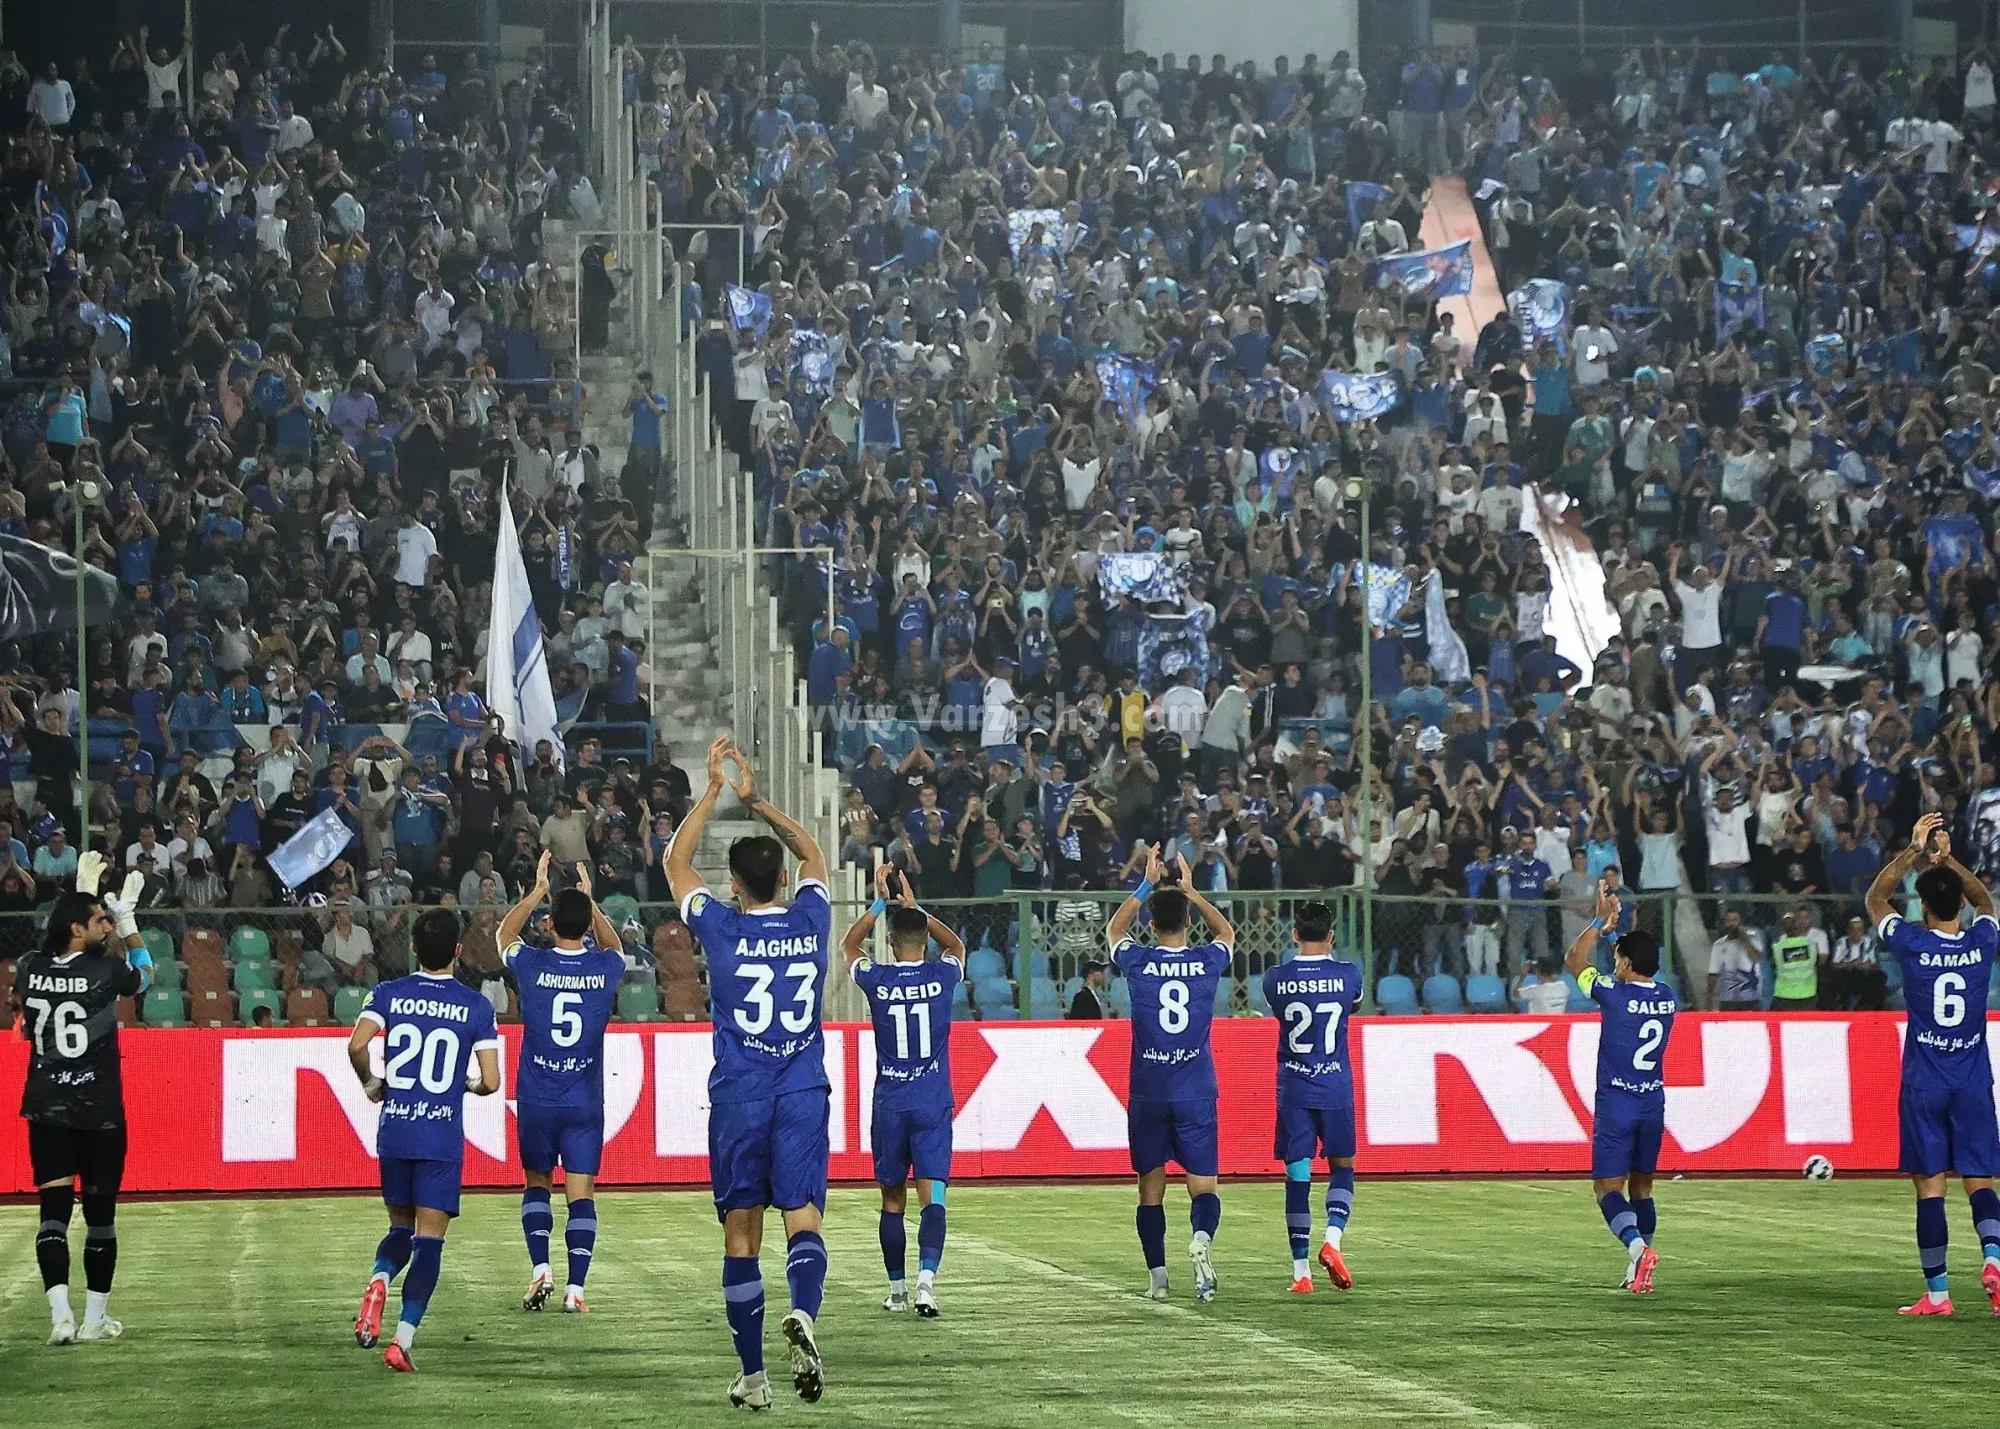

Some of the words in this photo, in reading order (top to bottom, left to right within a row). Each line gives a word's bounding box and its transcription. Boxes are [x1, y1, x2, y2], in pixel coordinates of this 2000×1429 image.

[735, 934, 818, 958] A.AGHASI
[1919, 948, 1982, 967] SAMAN
[536, 971, 605, 990] ASHURMATOV
[1142, 961, 1206, 977] AMIR
[28, 973, 89, 994] HABIB
[876, 981, 942, 1001] SAEID
[1277, 978, 1344, 995] HOSSEIN
[389, 997, 469, 1023] KOOSHKI
[733, 961, 819, 1035] 33
[1159, 980, 1190, 1034] 8
[1627, 999, 1676, 1015] SALEH
[1933, 971, 1966, 1027] 6
[25, 997, 89, 1059] 76
[550, 991, 583, 1048] 5
[887, 1002, 931, 1059] 11
[1284, 1001, 1343, 1055] 27
[1632, 1019, 1664, 1071] 2
[386, 1022, 460, 1094] 20
[410, 1100, 428, 1121] گاز
[427, 1103, 454, 1121] پالایش
